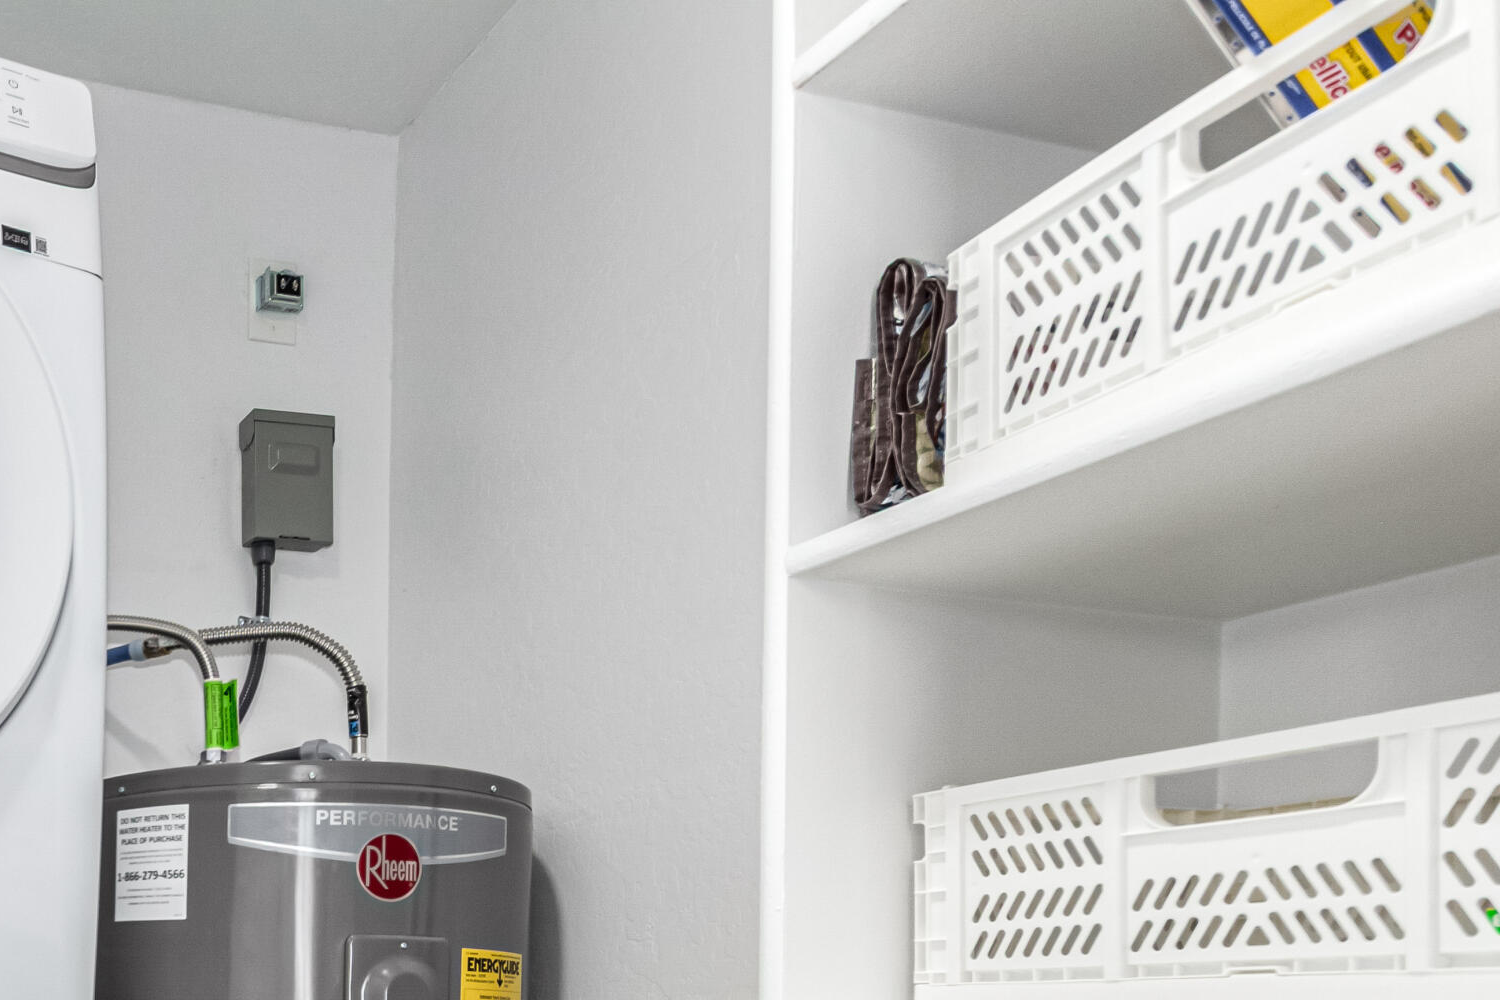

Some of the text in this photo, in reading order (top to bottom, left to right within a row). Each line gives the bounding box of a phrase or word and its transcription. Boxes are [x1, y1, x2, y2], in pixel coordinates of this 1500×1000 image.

[120, 812, 186, 825] DO NOT RETURN THIS
[315, 808, 460, 832] PERFORMANCE
[119, 827, 138, 835] WATER
[139, 824, 162, 833] HEATER
[121, 834, 183, 845] PLACE OF PURCHASE
[364, 834, 419, 890] Rheem
[117, 869, 186, 883] 1-866-279-4566
